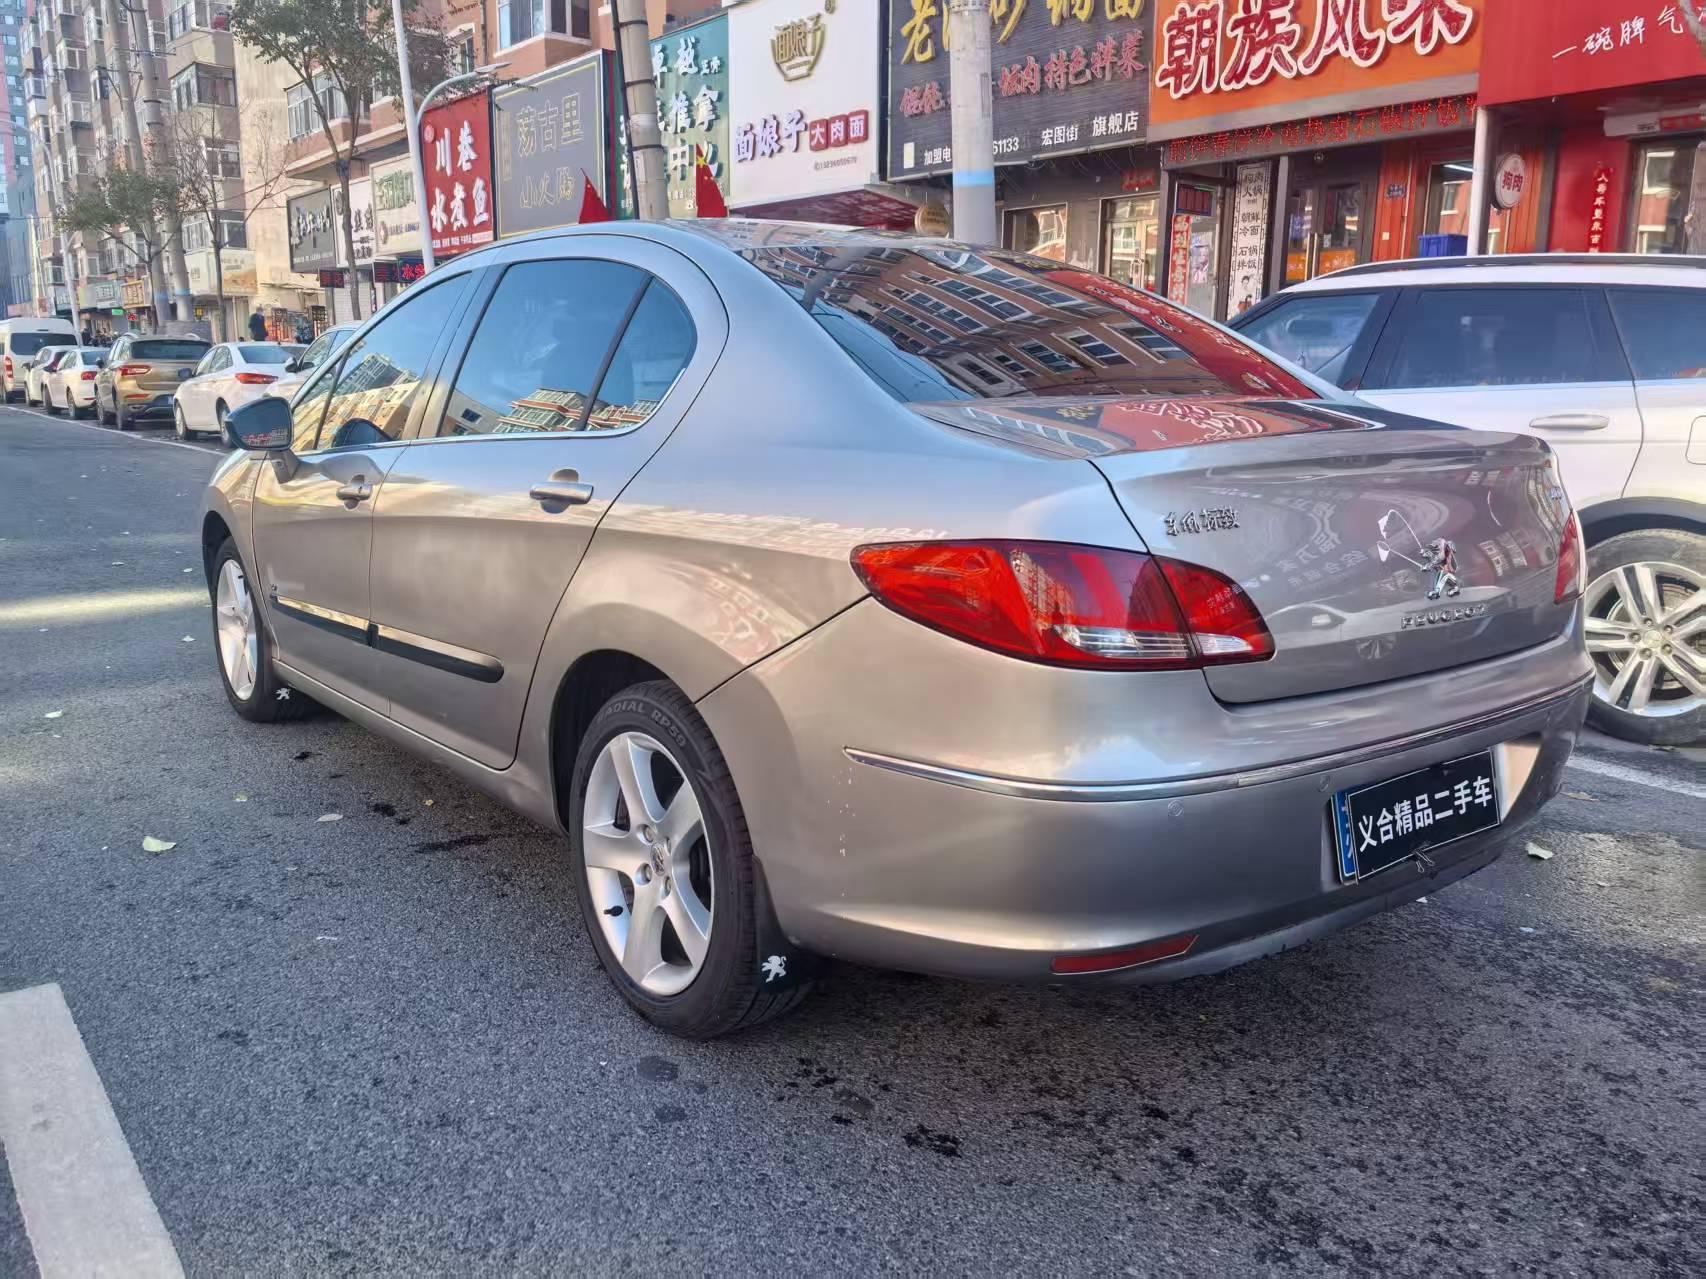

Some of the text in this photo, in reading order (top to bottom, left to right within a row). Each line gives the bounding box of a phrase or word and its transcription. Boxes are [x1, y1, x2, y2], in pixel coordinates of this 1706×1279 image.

[736, 109, 865, 163] 面娘子 大肉面
[1041, 126, 1079, 147] 宏图街
[1092, 112, 1139, 137] 旗舰店
[1502, 170, 1523, 192] 狗肉
[430, 177, 488, 233] 水煮鱼
[1241, 212, 1260, 223] 朝鲜
[1239, 225, 1260, 236] 冷面
[1238, 245, 1258, 257] 石锅
[1236, 259, 1257, 271] 拌饭
[1164, 505, 1239, 536] 东风标致
[1401, 604, 1486, 629] PEUGEOT
[1358, 776, 1494, 852] 义合精品二手车
